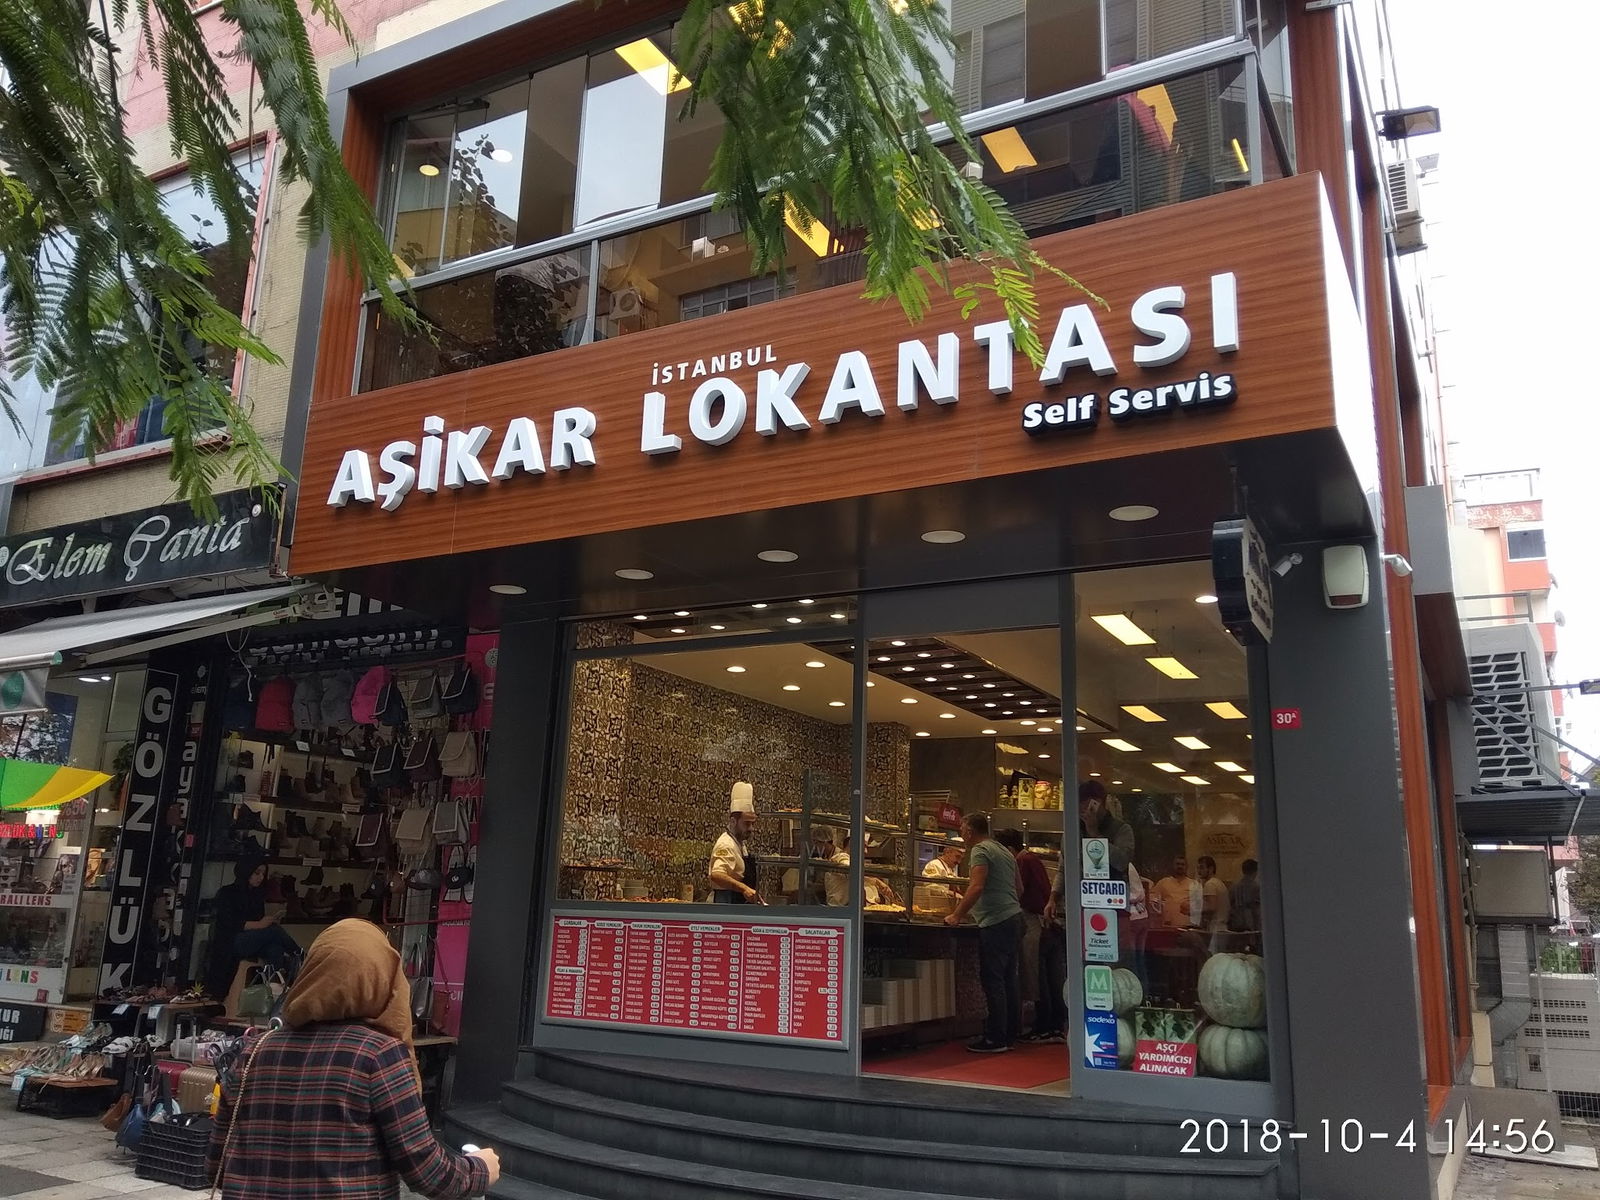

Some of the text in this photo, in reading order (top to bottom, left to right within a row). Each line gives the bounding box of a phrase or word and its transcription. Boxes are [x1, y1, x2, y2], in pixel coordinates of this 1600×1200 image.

[652, 345, 777, 386] İSTANBUL
[327, 271, 1239, 511] AŞİKAR LOKANTASI
[1022, 372, 1233, 429] Self Servis
[6, 515, 249, 585] Elem Çanta
[98, 686, 172, 996] GÖZLÜK
[1082, 882, 1125, 896] SETCARD
[26, 895, 52, 906] LENS
[6, 968, 39, 984] LENS
[1090, 972, 1108, 991] M
[1088, 1015, 1116, 1024] sodexo
[1155, 1042, 1177, 1053] AŞÇI
[1139, 1052, 1192, 1065] YARDIMCISI
[1139, 1063, 1187, 1075] ALINACAK
